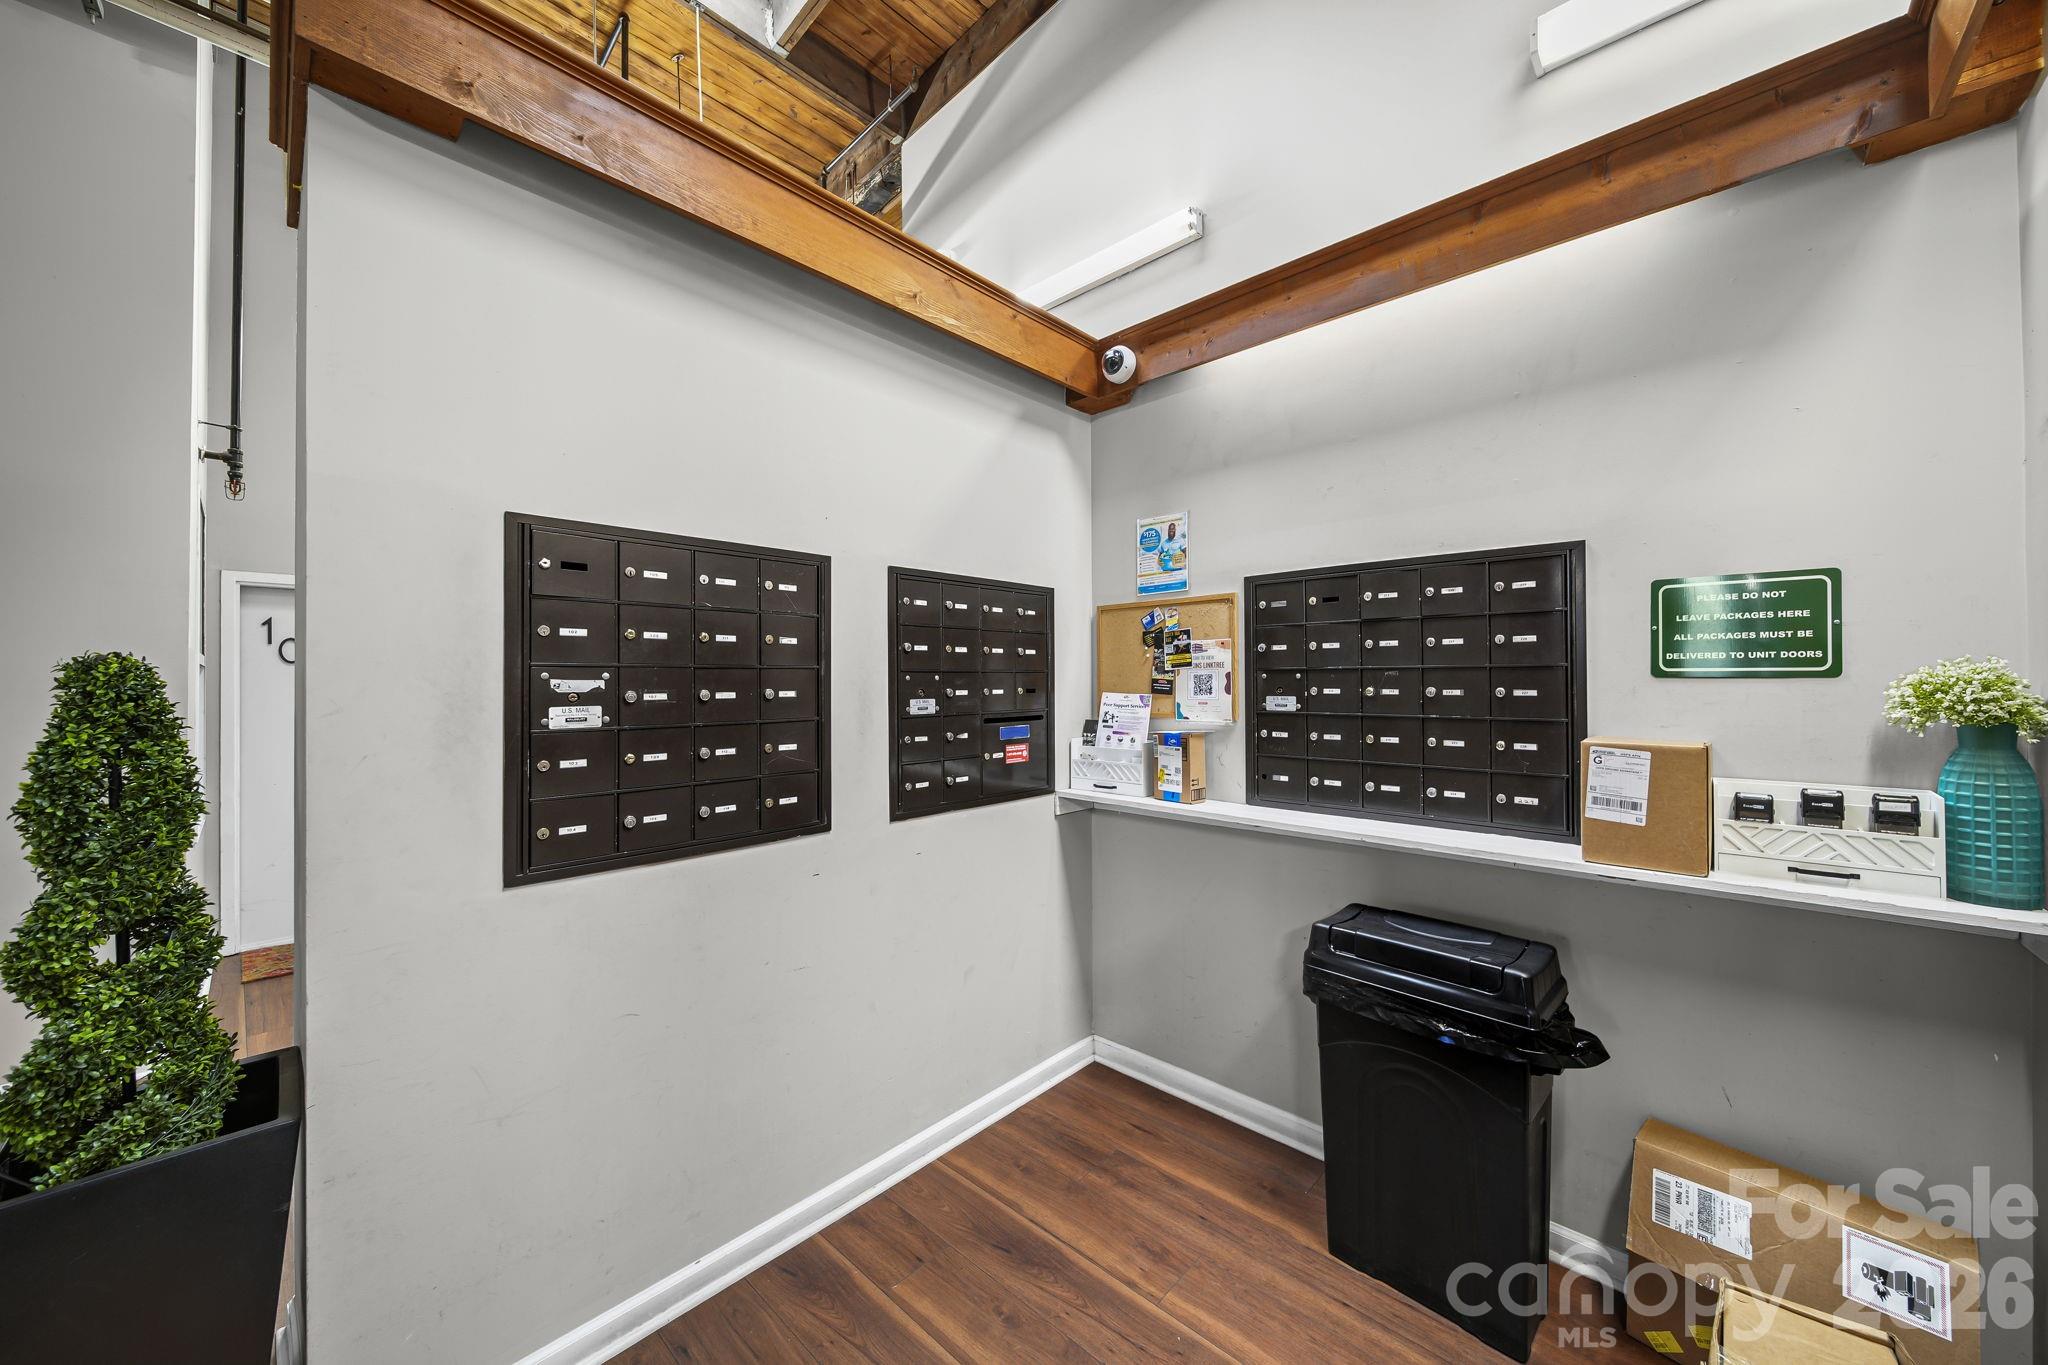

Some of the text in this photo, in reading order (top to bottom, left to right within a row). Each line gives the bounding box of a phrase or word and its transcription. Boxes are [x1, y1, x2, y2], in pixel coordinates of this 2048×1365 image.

[1696, 590, 1787, 602] PLEASE DO NOT
[1676, 609, 1811, 622] LEAVE PACKAGES HERE
[1673, 629, 1814, 641] ALL PACKAGES MUST BE
[1666, 650, 1823, 660] DELIVERED TO UNIT DOORS
[1203, 661, 1225, 669] LINKTREE
[1593, 755, 1603, 765] G
